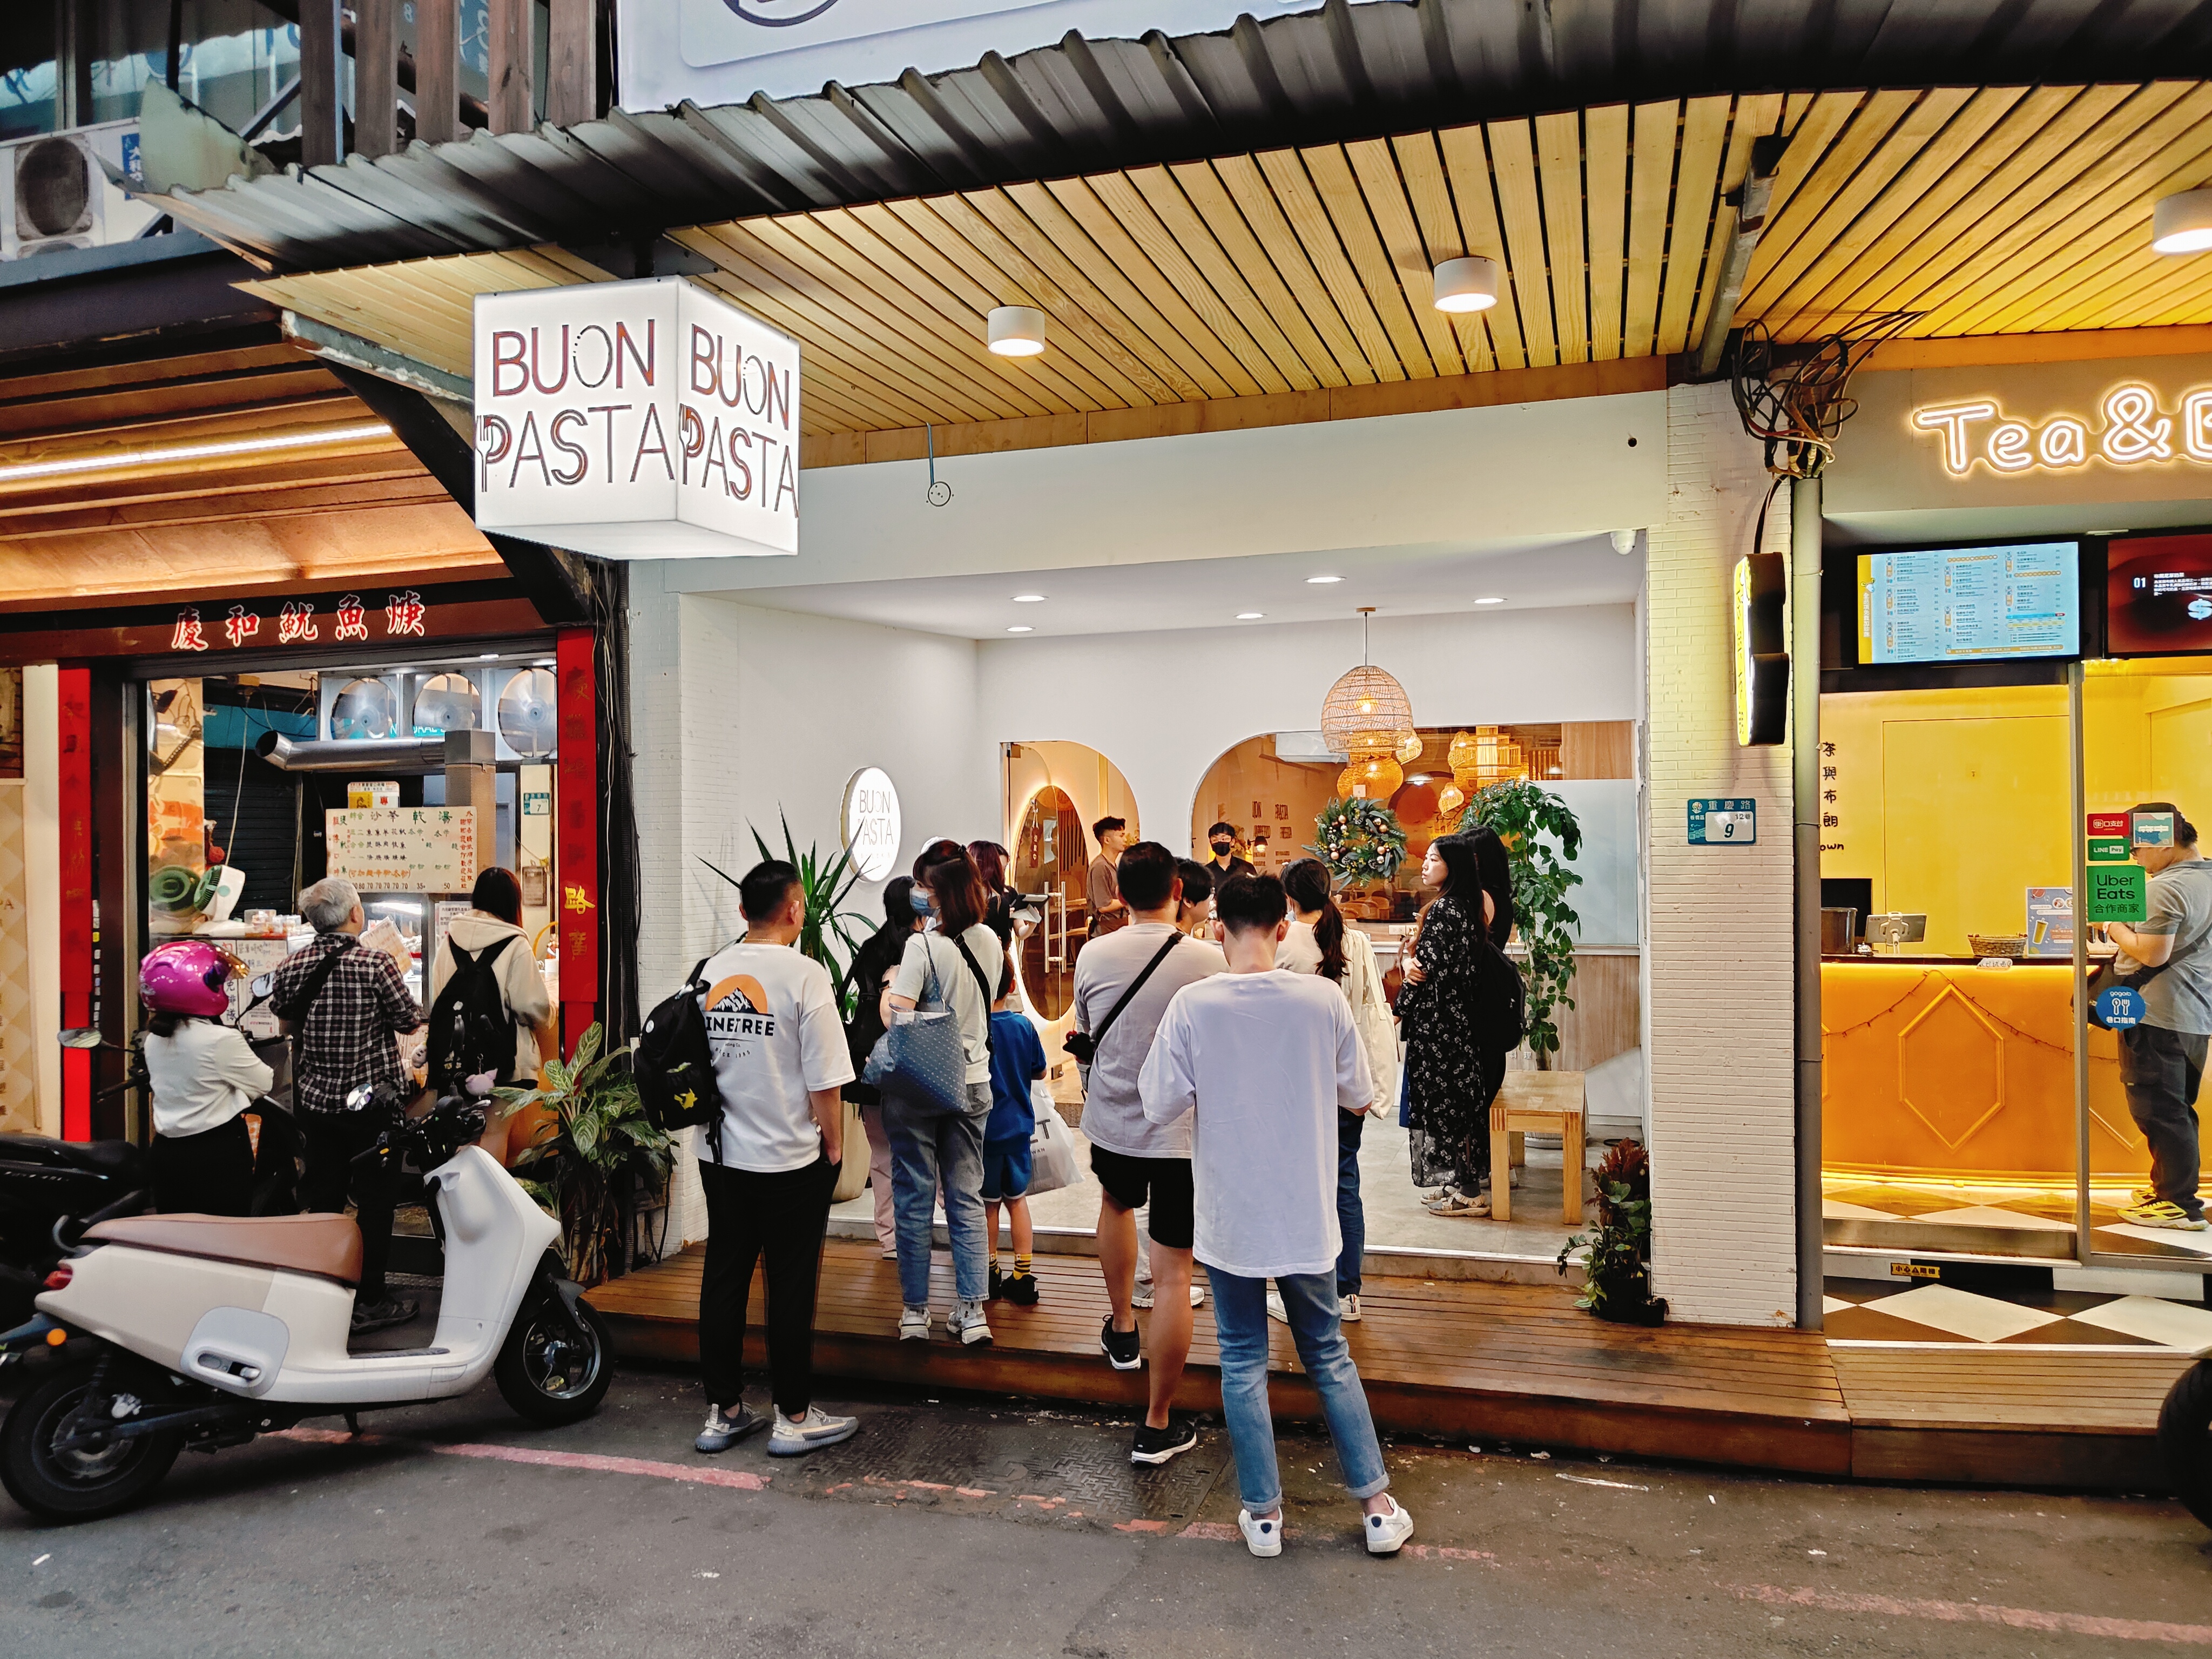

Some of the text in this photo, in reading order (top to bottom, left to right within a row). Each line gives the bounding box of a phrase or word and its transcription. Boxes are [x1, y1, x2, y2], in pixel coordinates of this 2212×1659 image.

[493, 319, 655, 397] BUON
[691, 323, 789, 431] BUON
[476, 403, 675, 493] PASTA
[679, 403, 799, 518] PASTA
[2134, 577, 2146, 589] 01
[1823, 741, 1839, 828] 茶與布朗
[860, 790, 890, 813] BUON
[1708, 800, 1750, 810] 重慶路
[370, 810, 400, 822] 沙茶
[413, 810, 427, 825] 乾
[439, 811, 453, 824] 湯
[1724, 823, 1735, 838] 9
[1819, 843, 1844, 852] own
[2111, 847, 2123, 855] Pay
[2096, 874, 2135, 886] Uber
[2097, 887, 2135, 900] Eats
[2094, 903, 2140, 914] 合作商家
[706, 1016, 775, 1036] INETREE
[1031, 1147, 1046, 1155] WAN
